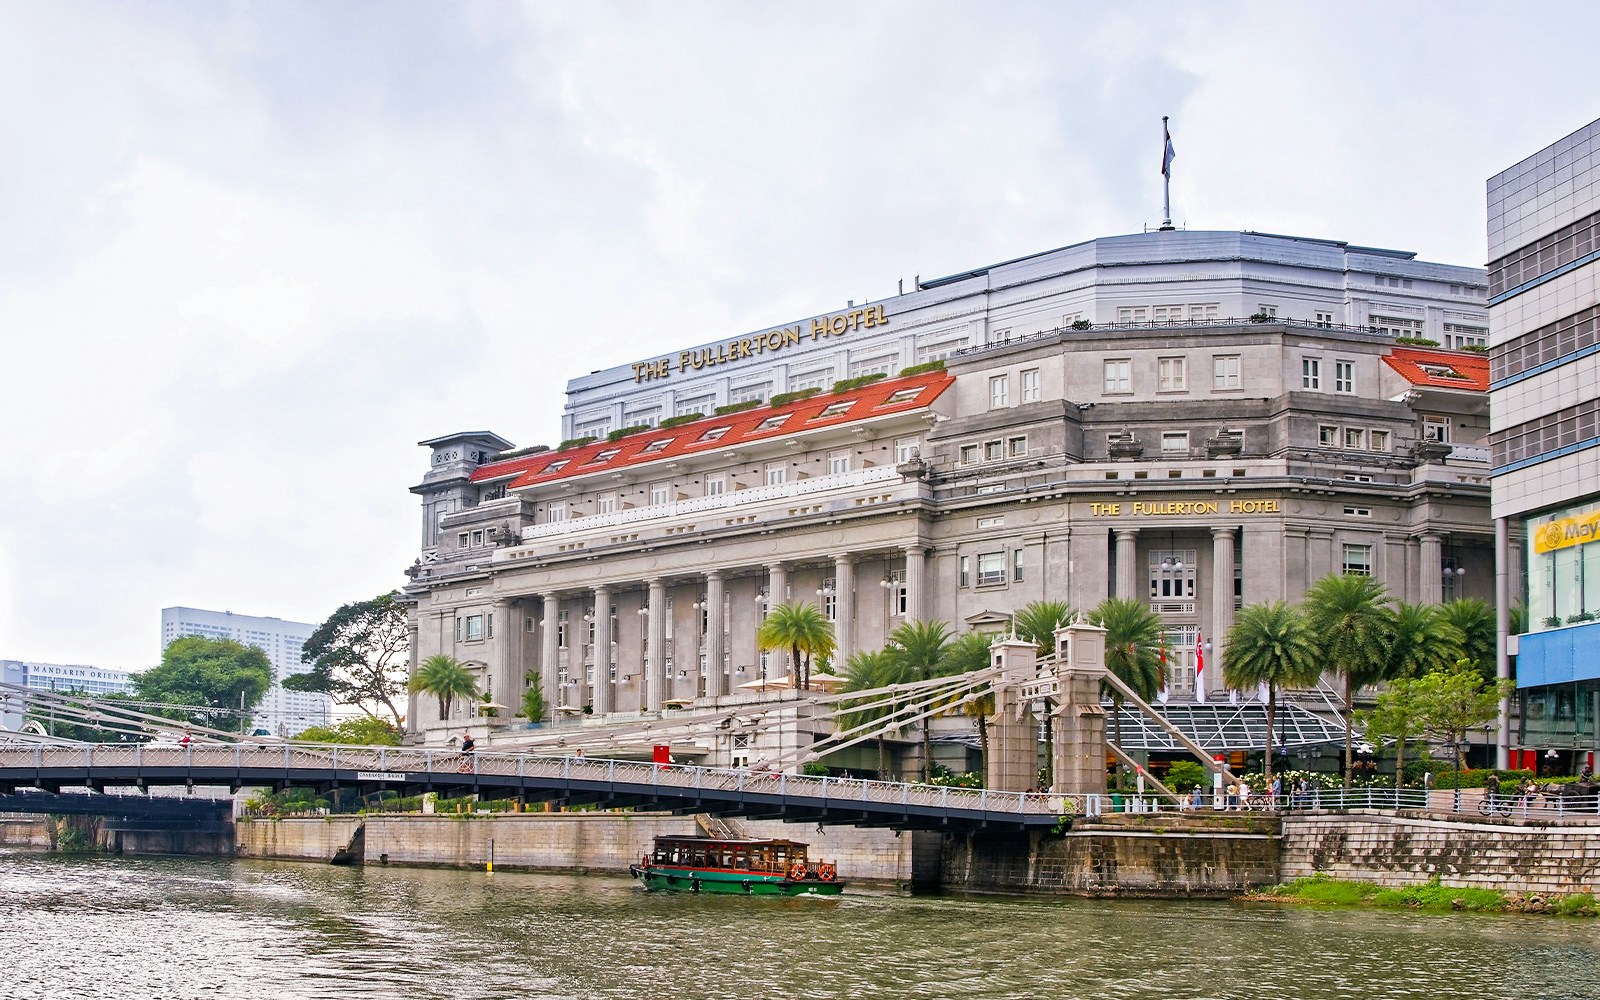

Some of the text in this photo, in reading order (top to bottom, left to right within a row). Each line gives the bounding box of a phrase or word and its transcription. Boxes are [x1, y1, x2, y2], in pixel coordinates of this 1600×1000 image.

[632, 304, 889, 383] THE FULLERTON HOTEL
[1090, 500, 1281, 516] THE FULLERTON HOTEL
[1565, 519, 1600, 540] May
[33, 665, 86, 677] MANDARIN
